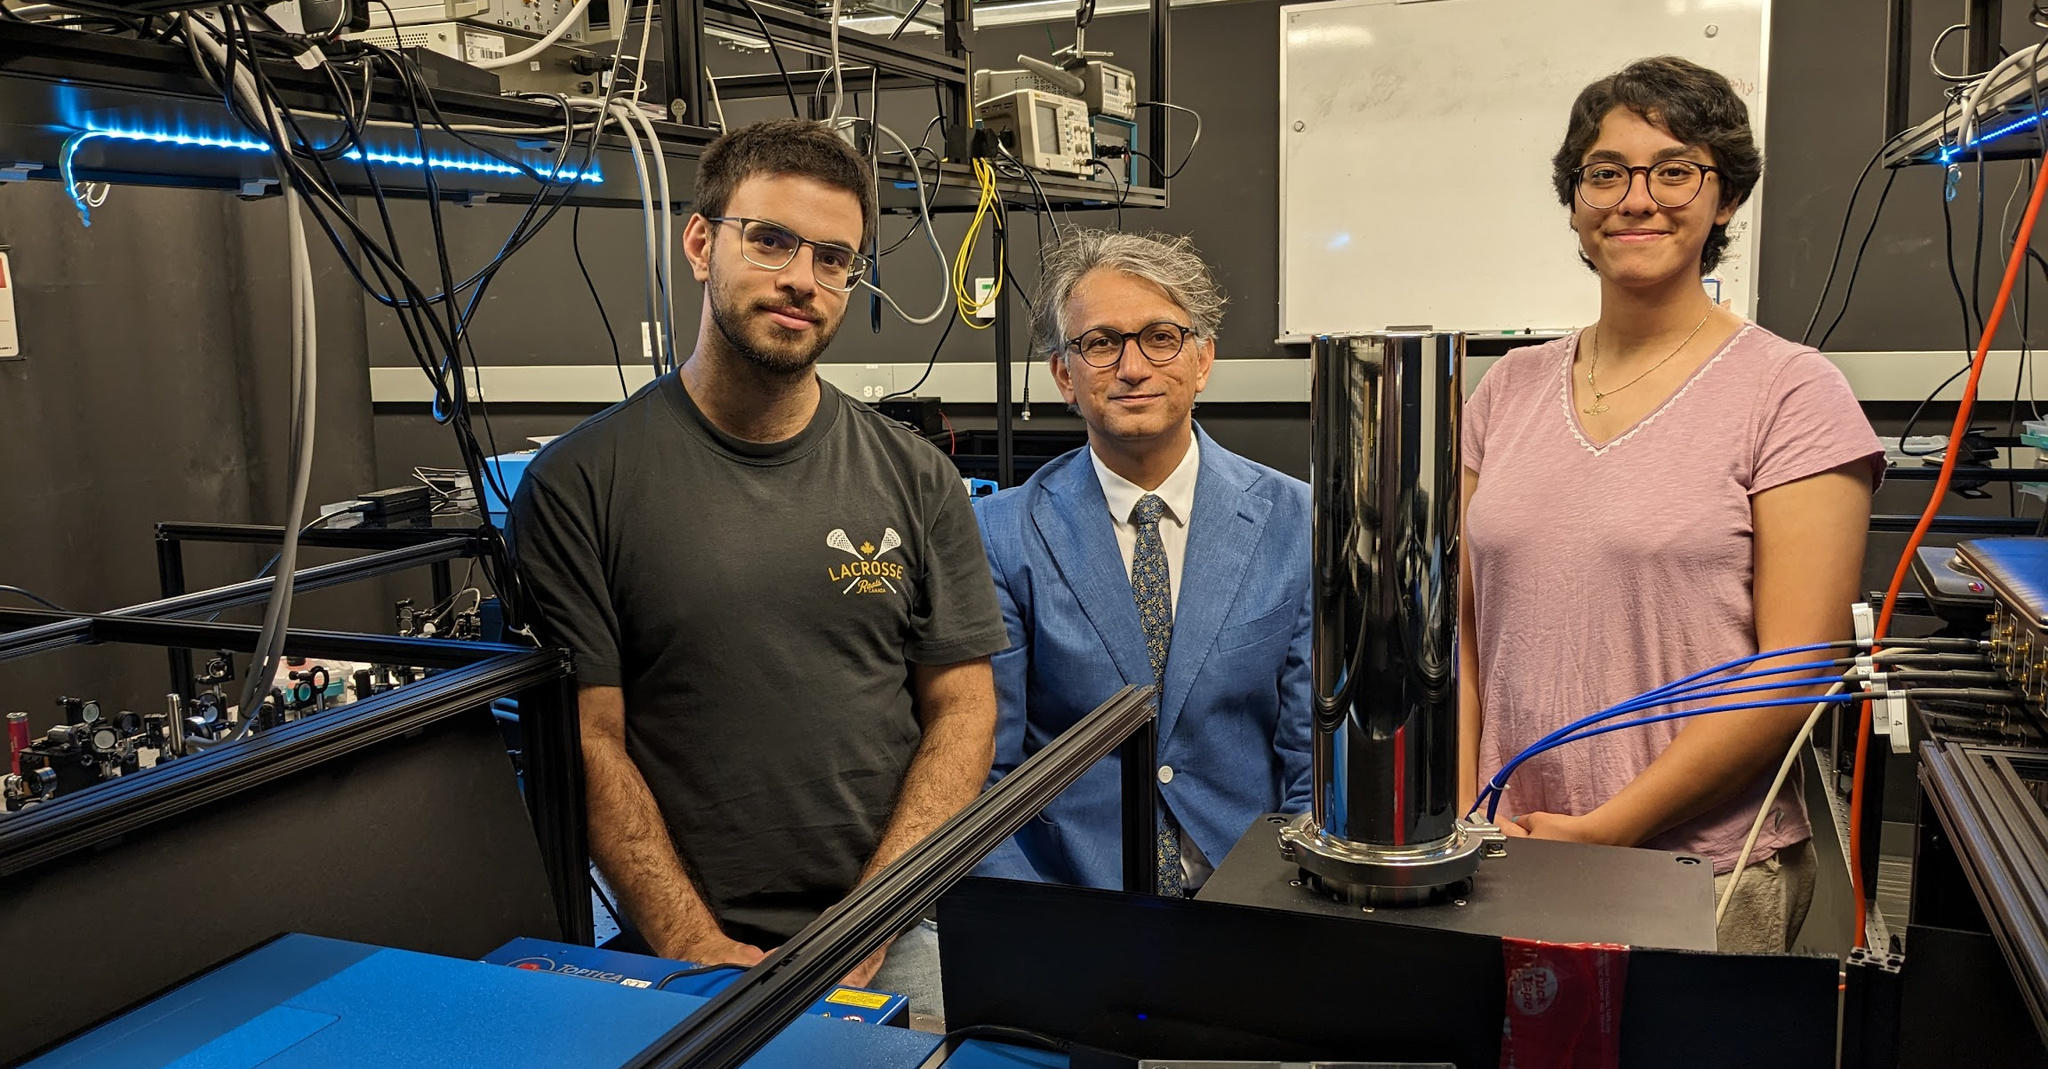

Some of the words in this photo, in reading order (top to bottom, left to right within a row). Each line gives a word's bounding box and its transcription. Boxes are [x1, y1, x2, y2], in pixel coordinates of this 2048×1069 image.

[828, 561, 904, 582] LACROSSE
[856, 579, 883, 594] Roots
[557, 963, 624, 982] TOPTICA
[1520, 975, 1533, 1010] Tape
